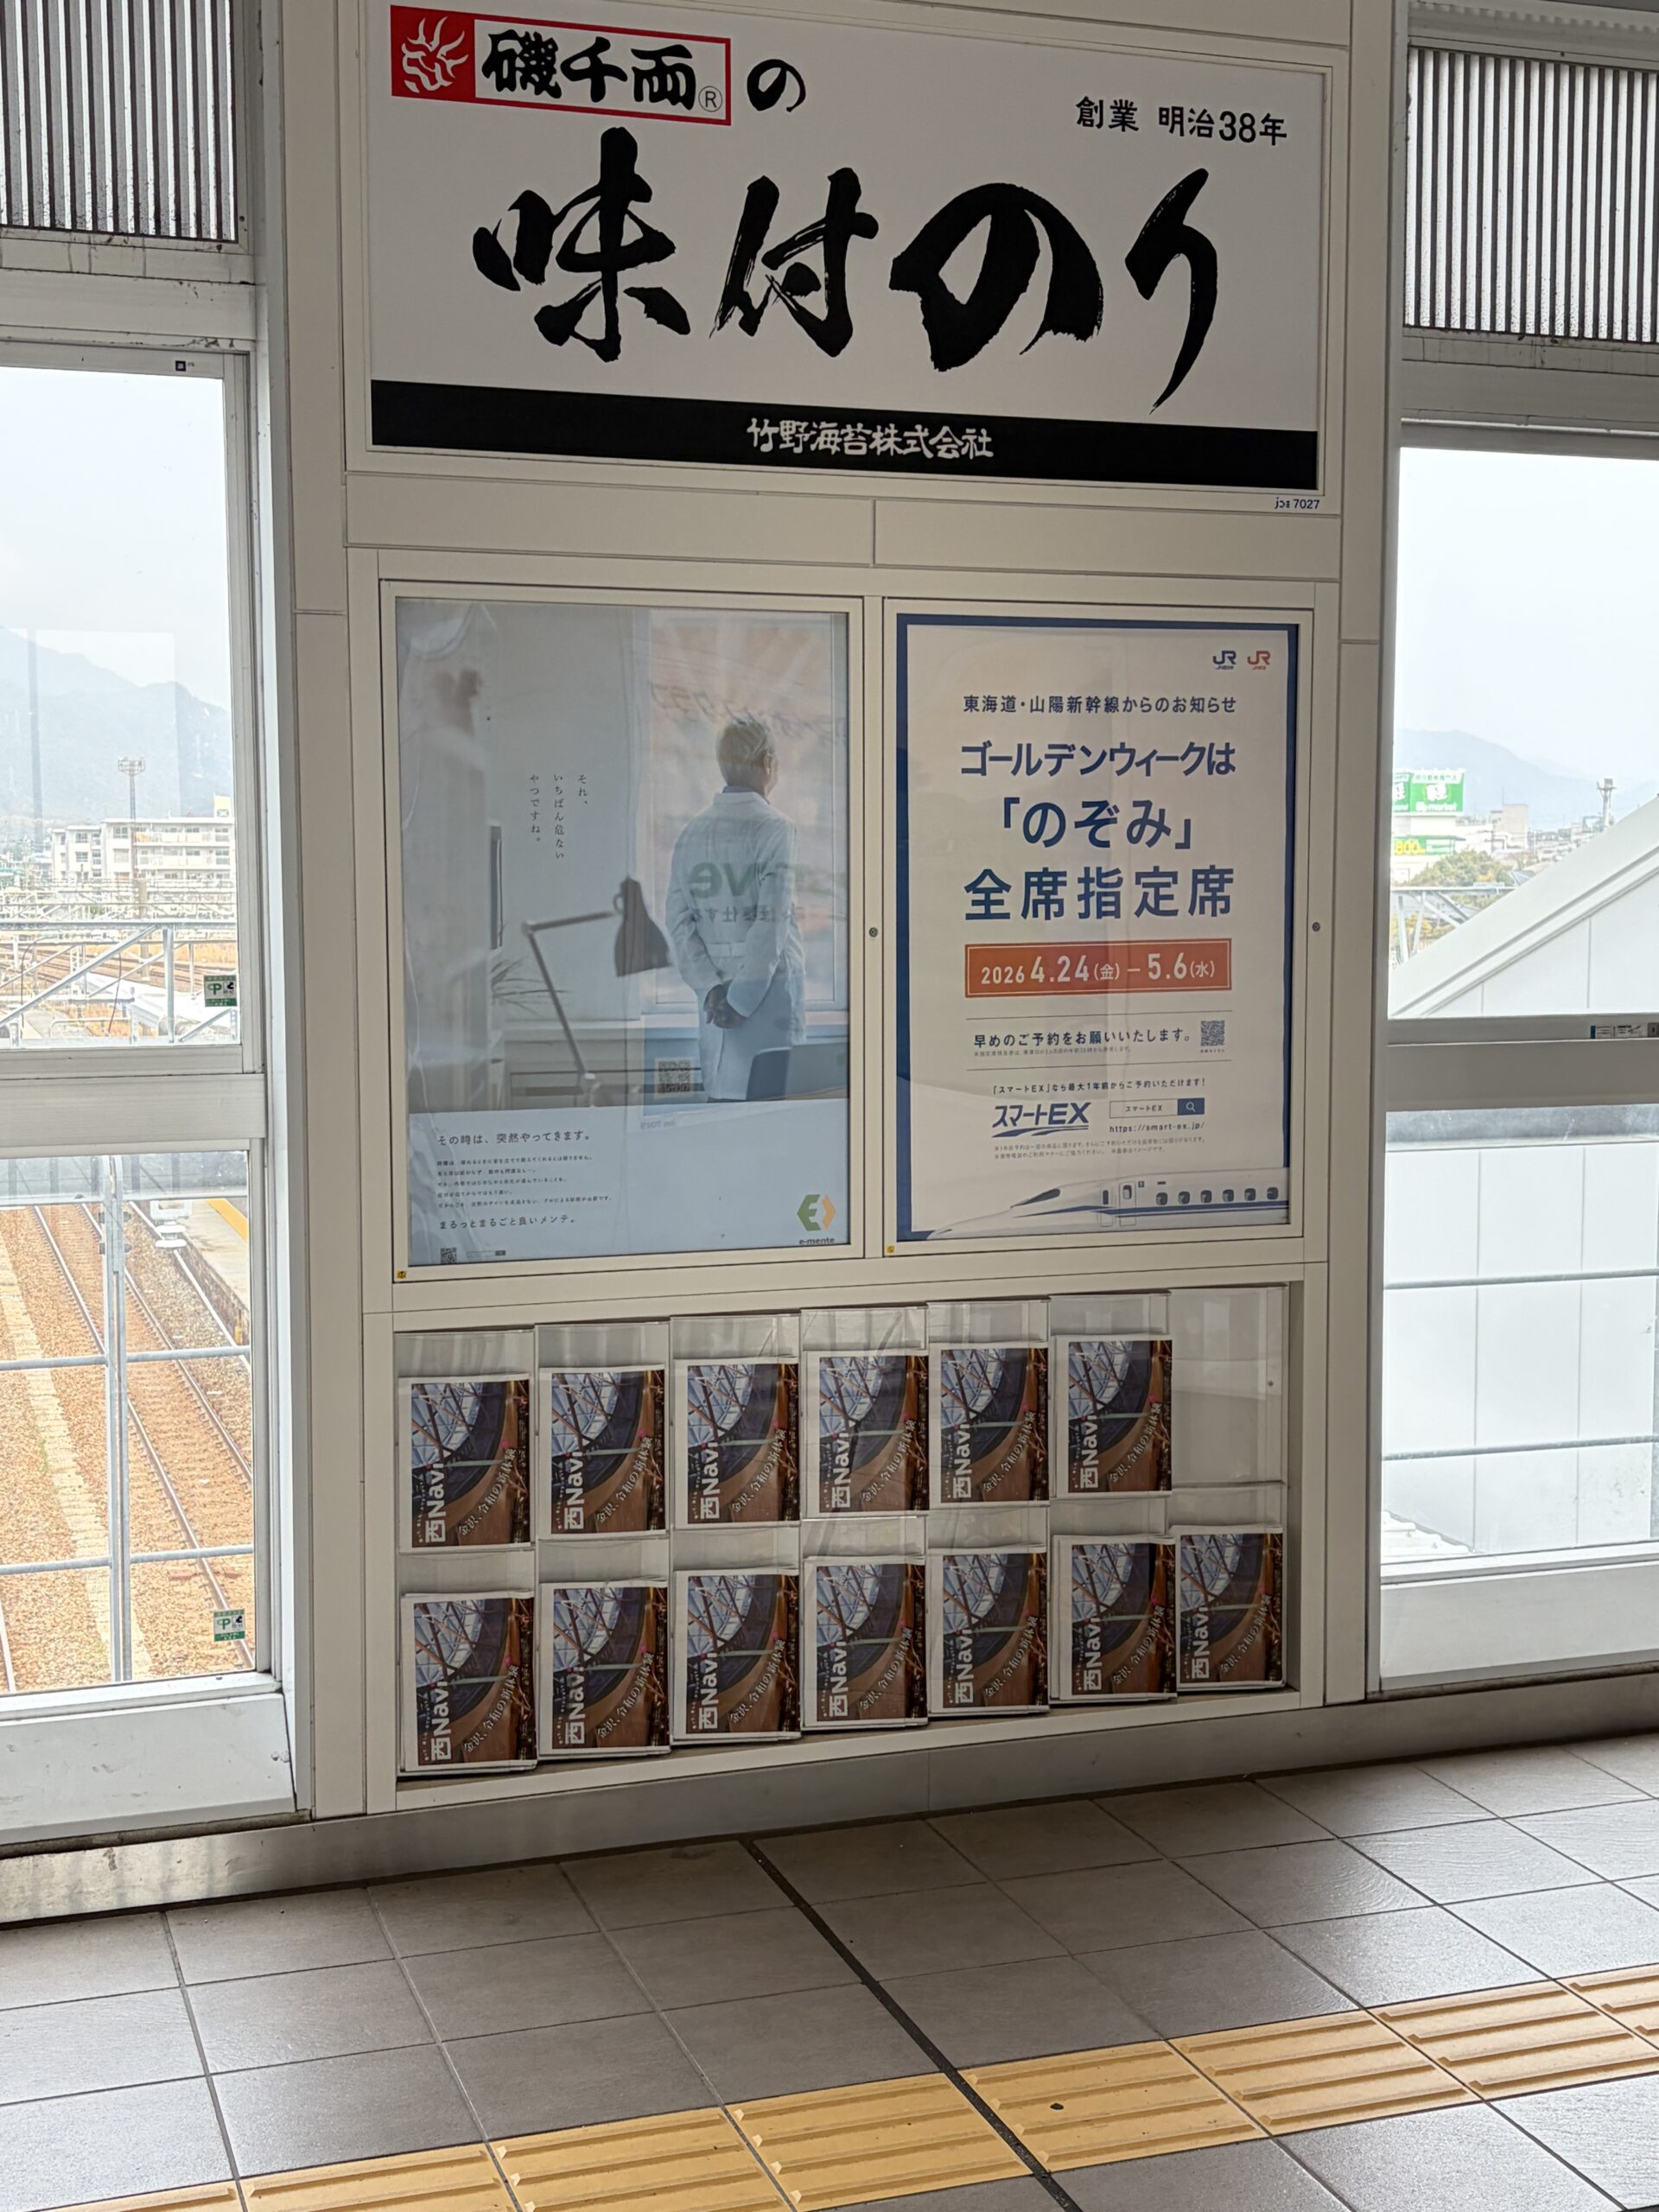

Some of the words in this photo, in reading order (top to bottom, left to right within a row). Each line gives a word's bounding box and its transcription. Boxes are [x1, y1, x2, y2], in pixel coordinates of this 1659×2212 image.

[747, 59, 806, 112] の
[1076, 96, 1140, 131] 創業
[1158, 105, 1287, 146] 明治38年
[473, 126, 1218, 415] 味付のり
[747, 418, 994, 460] 竹野海苔株式会社
[1294, 499, 1320, 510] 7027
[1213, 650, 1237, 666] JR
[1247, 650, 1271, 666] JR
[963, 694, 1236, 715] 東海道・山陽新幹線からのお知らせ
[961, 740, 1236, 778] ゴールデンウィークは
[530, 774, 541, 842] やつですね。
[1003, 797, 1192, 850] 「のぞみ」
[963, 865, 1234, 921] 全席指定席
[981, 965, 1025, 985] 2026
[1031, 955, 1121, 983] 4.24(金)
[1147, 951, 1216, 981] 5.6(水)
[974, 1027, 1190, 1048] 早めのご予約をお願いいたします。
[436, 1130, 591, 1147] その時は、突然やってきます。
[992, 1102, 1091, 1128] スマートEX
[439, 1214, 575, 1230] まるっとまるごと良いメンテ。
[799, 1236, 835, 1245] e-mente
[701, 1441, 720, 1519] 西Navi
[831, 1432, 851, 1508] 西Navi
[953, 1423, 972, 1498] 西Navi
[1080, 1414, 1098, 1489] 西Navi
[425, 1462, 446, 1543] 西Navi
[564, 1451, 585, 1529] 西Navi
[955, 1629, 975, 1704] 西Navi
[1083, 1618, 1102, 1691] 西Navi
[1192, 1607, 1210, 1679] 西Navi
[565, 1666, 586, 1745] 西Navi
[698, 1652, 718, 1730] 西Navi
[829, 1641, 849, 1717] 西Navi
[431, 1681, 452, 1760] 西Navi
